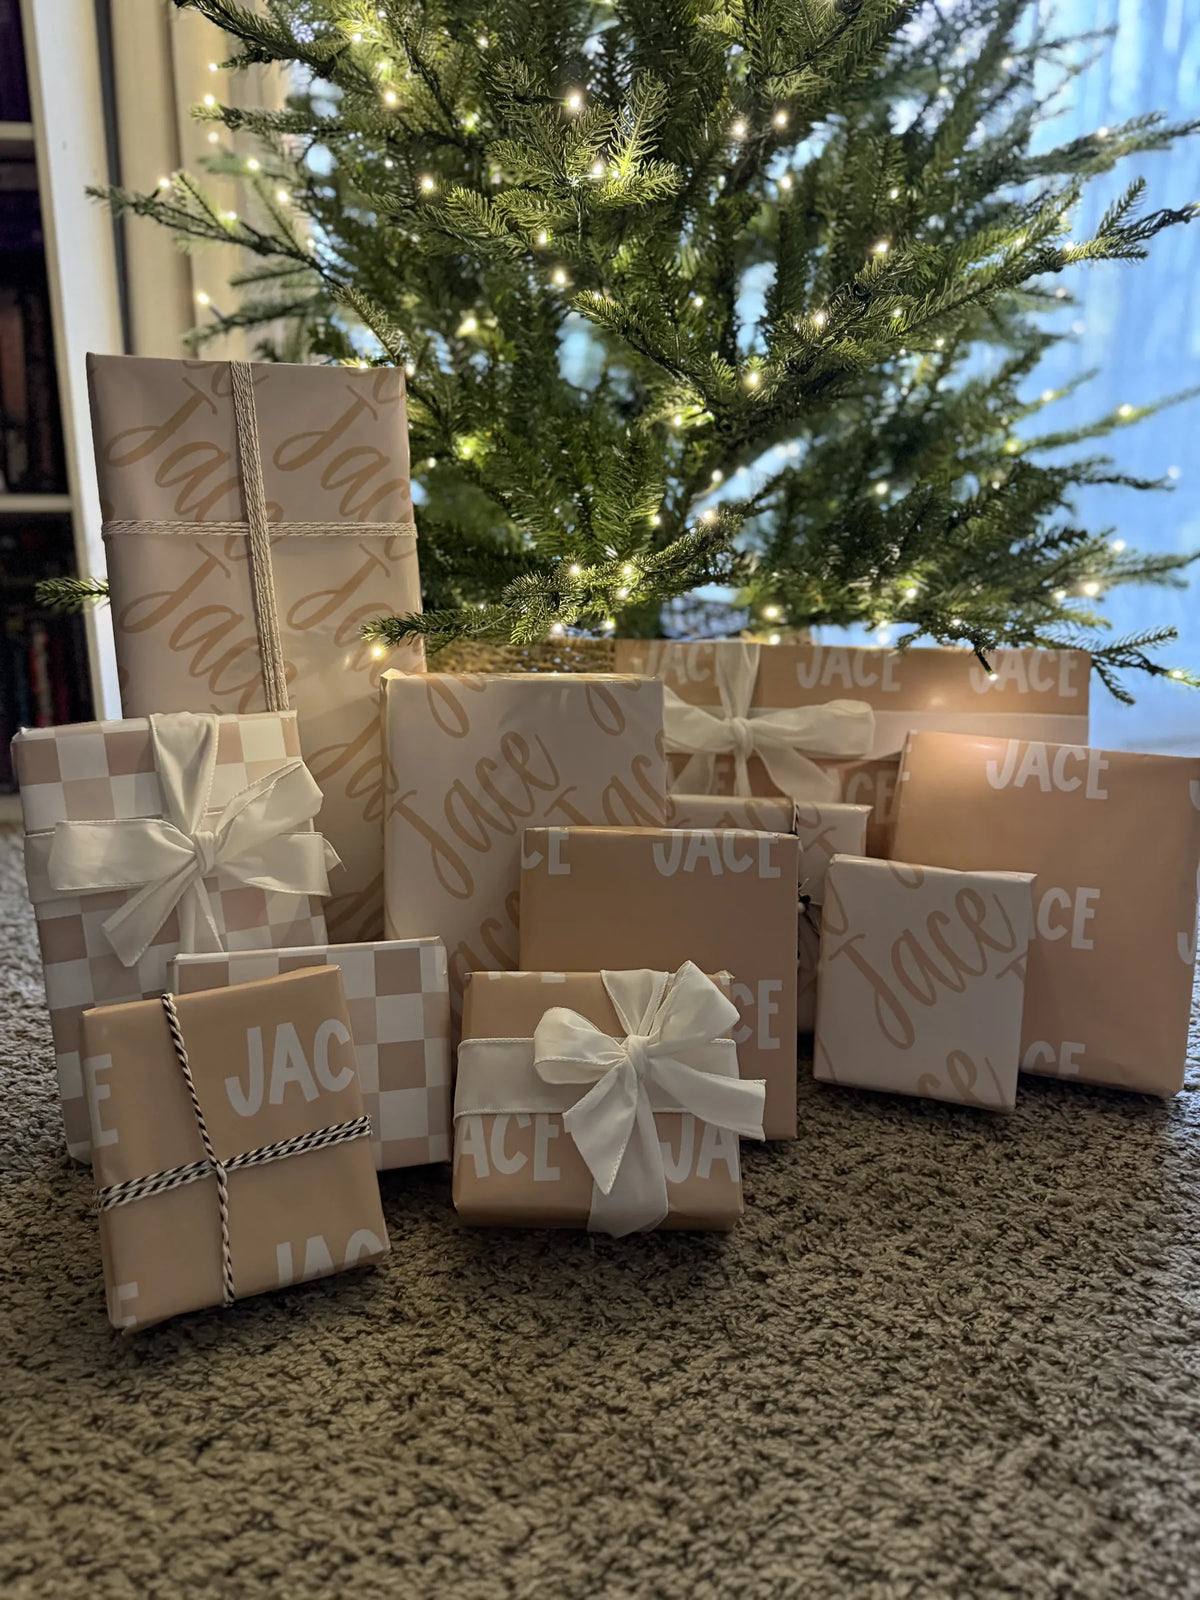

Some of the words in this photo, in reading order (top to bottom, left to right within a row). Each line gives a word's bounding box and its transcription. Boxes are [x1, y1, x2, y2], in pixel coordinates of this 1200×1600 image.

[796, 645, 900, 692] JACE
[969, 648, 1078, 697] JACE
[986, 738, 1109, 800] JACE
[387, 729, 560, 900] Jace
[652, 828, 781, 878] JACE
[828, 887, 1017, 1051] Jace
[224, 1018, 355, 1118] JAC
[453, 1113, 562, 1182] ACE
